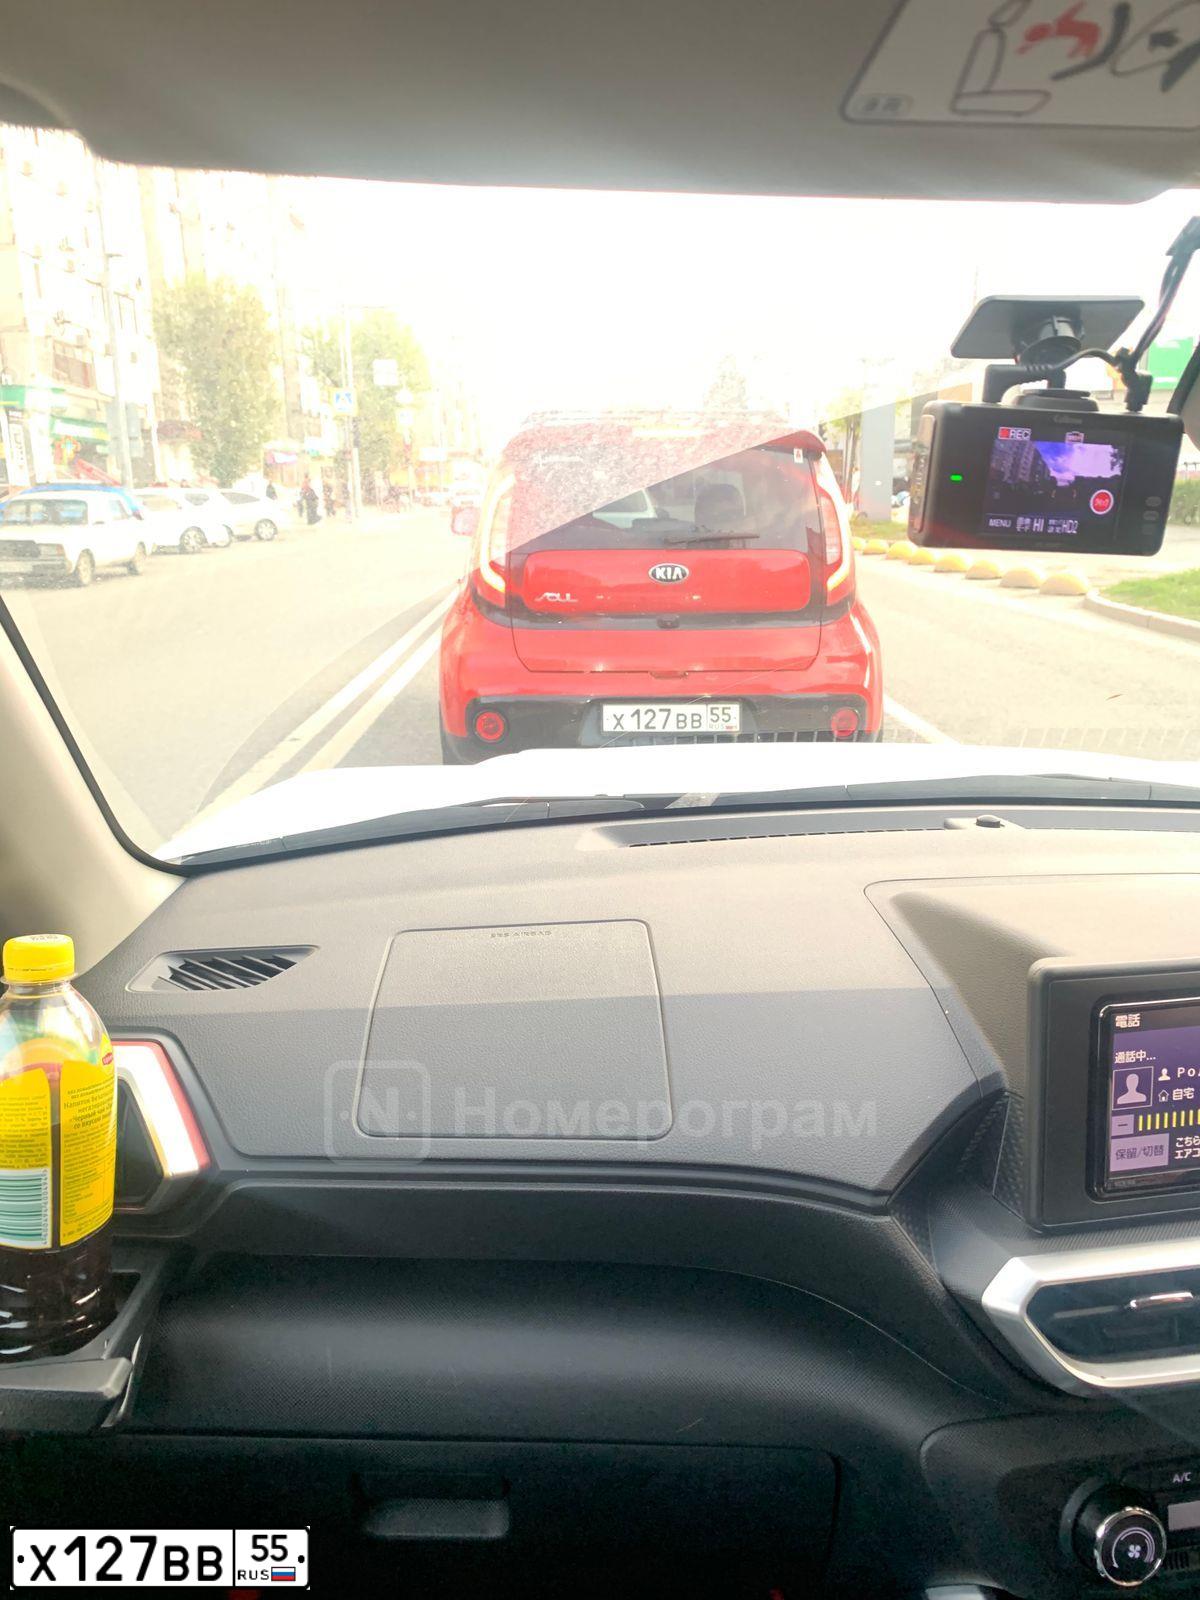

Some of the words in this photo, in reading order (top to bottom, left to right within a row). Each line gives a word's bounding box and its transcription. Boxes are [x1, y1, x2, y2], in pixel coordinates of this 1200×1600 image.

[1010, 429, 1030, 440] REC
[988, 518, 1012, 527] MENU
[1032, 517, 1044, 532] HI
[655, 566, 683, 580] KIA
[613, 708, 702, 730] Х127ВВ
[710, 706, 732, 723] 55
[1115, 1013, 1141, 1028] 電話
[1172, 1087, 1195, 1101] 自宅
[1175, 1136, 1200, 1148] こちら
[1115, 1144, 1165, 1161] 保留/切替
[1172, 1471, 1192, 1484] A/C
